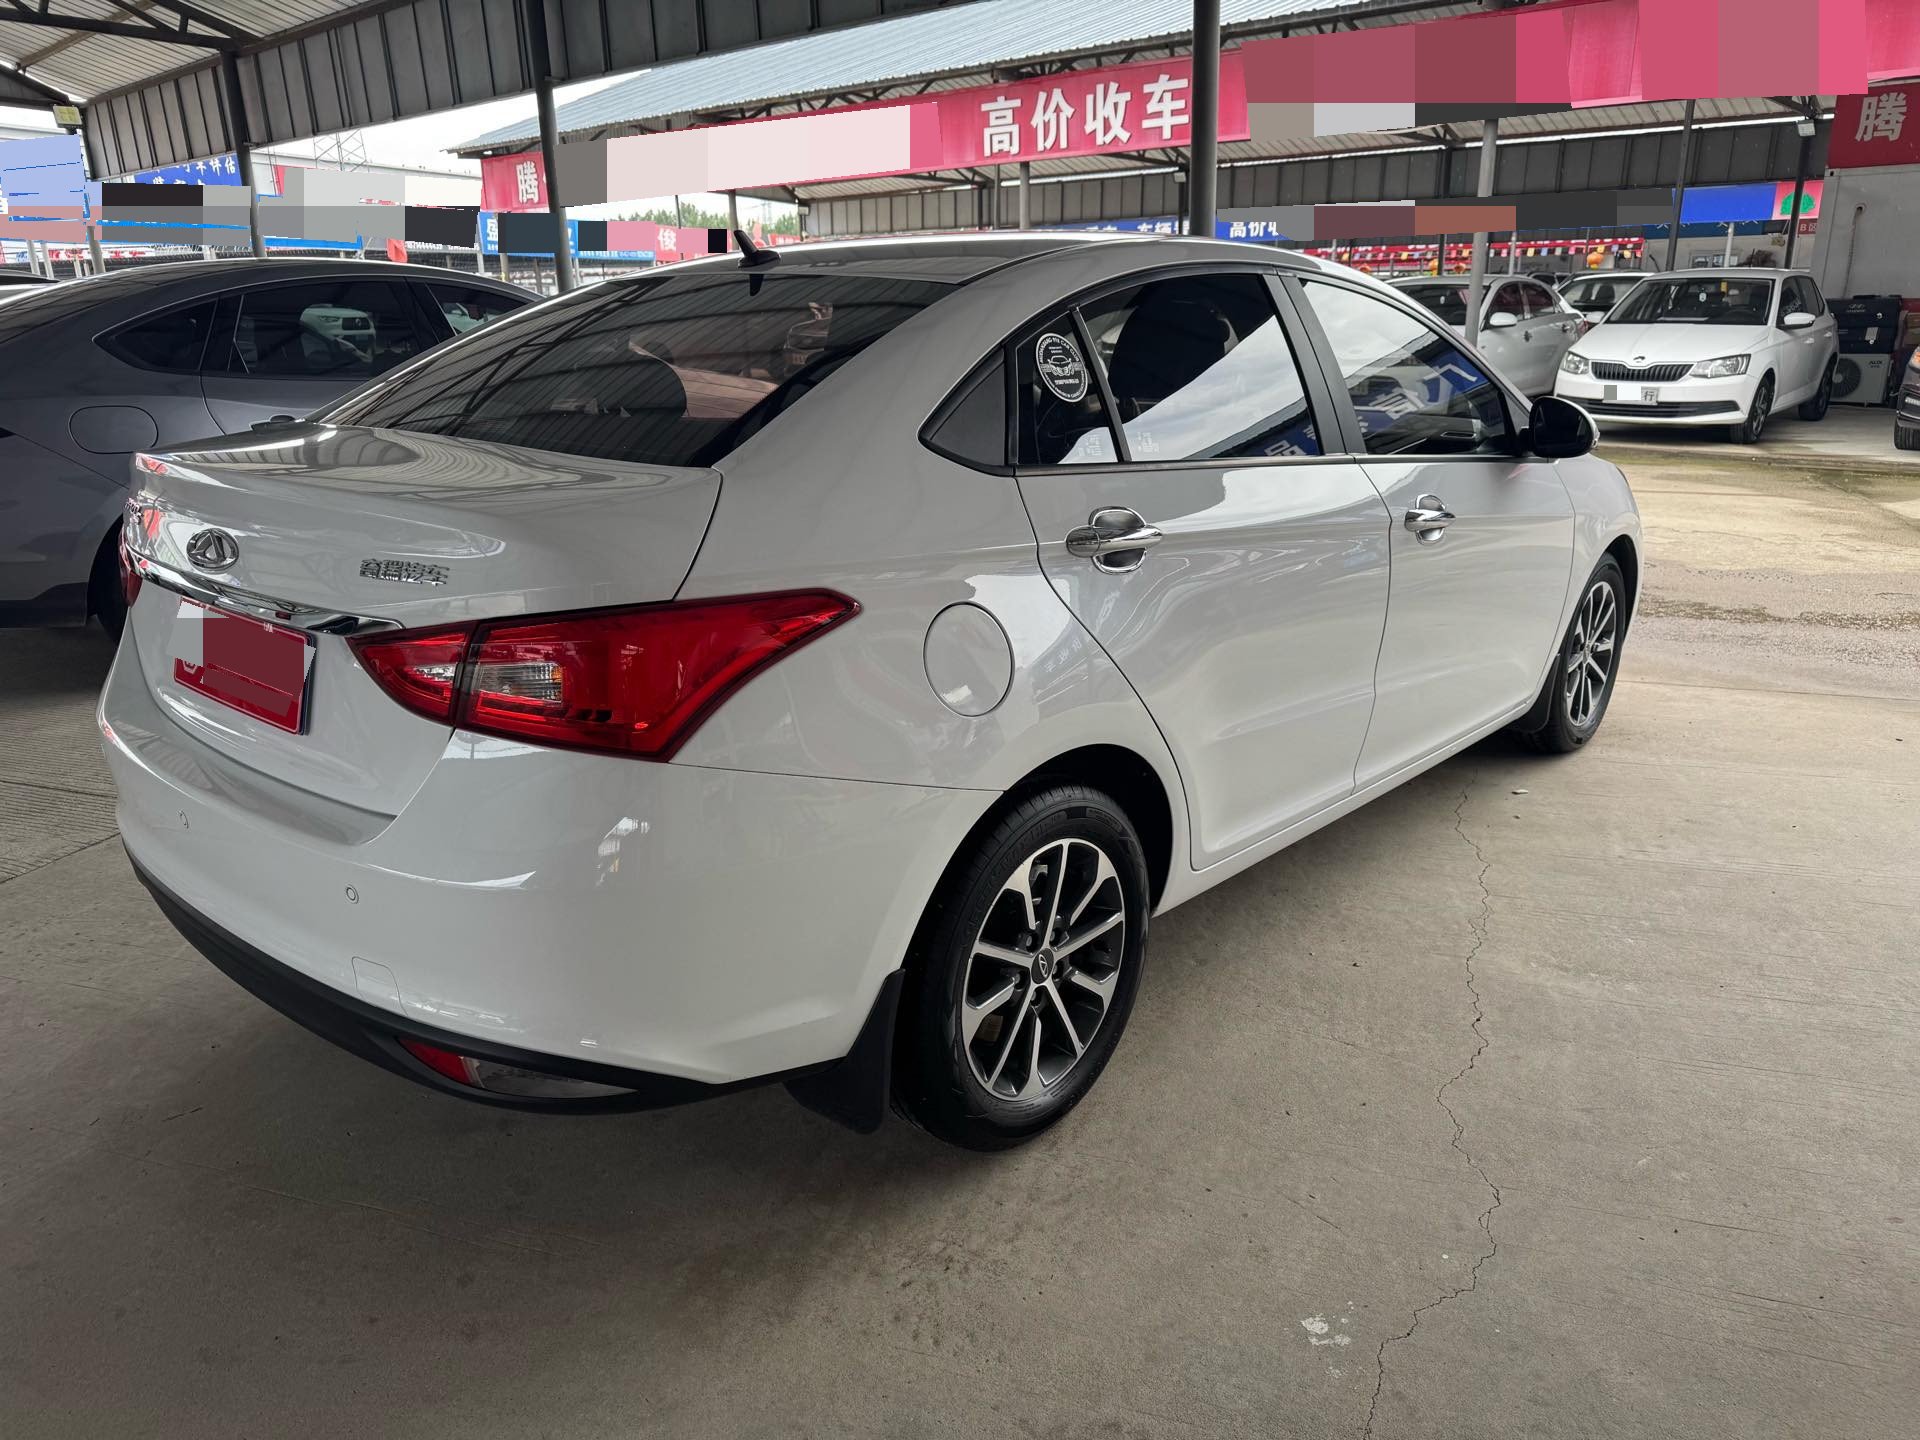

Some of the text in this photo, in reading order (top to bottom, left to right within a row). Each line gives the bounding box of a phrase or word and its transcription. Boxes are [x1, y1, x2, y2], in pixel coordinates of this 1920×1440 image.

[981, 74, 1190, 157] 高价收车
[1855, 92, 1907, 141] 腾
[516, 160, 547, 204] 腾
